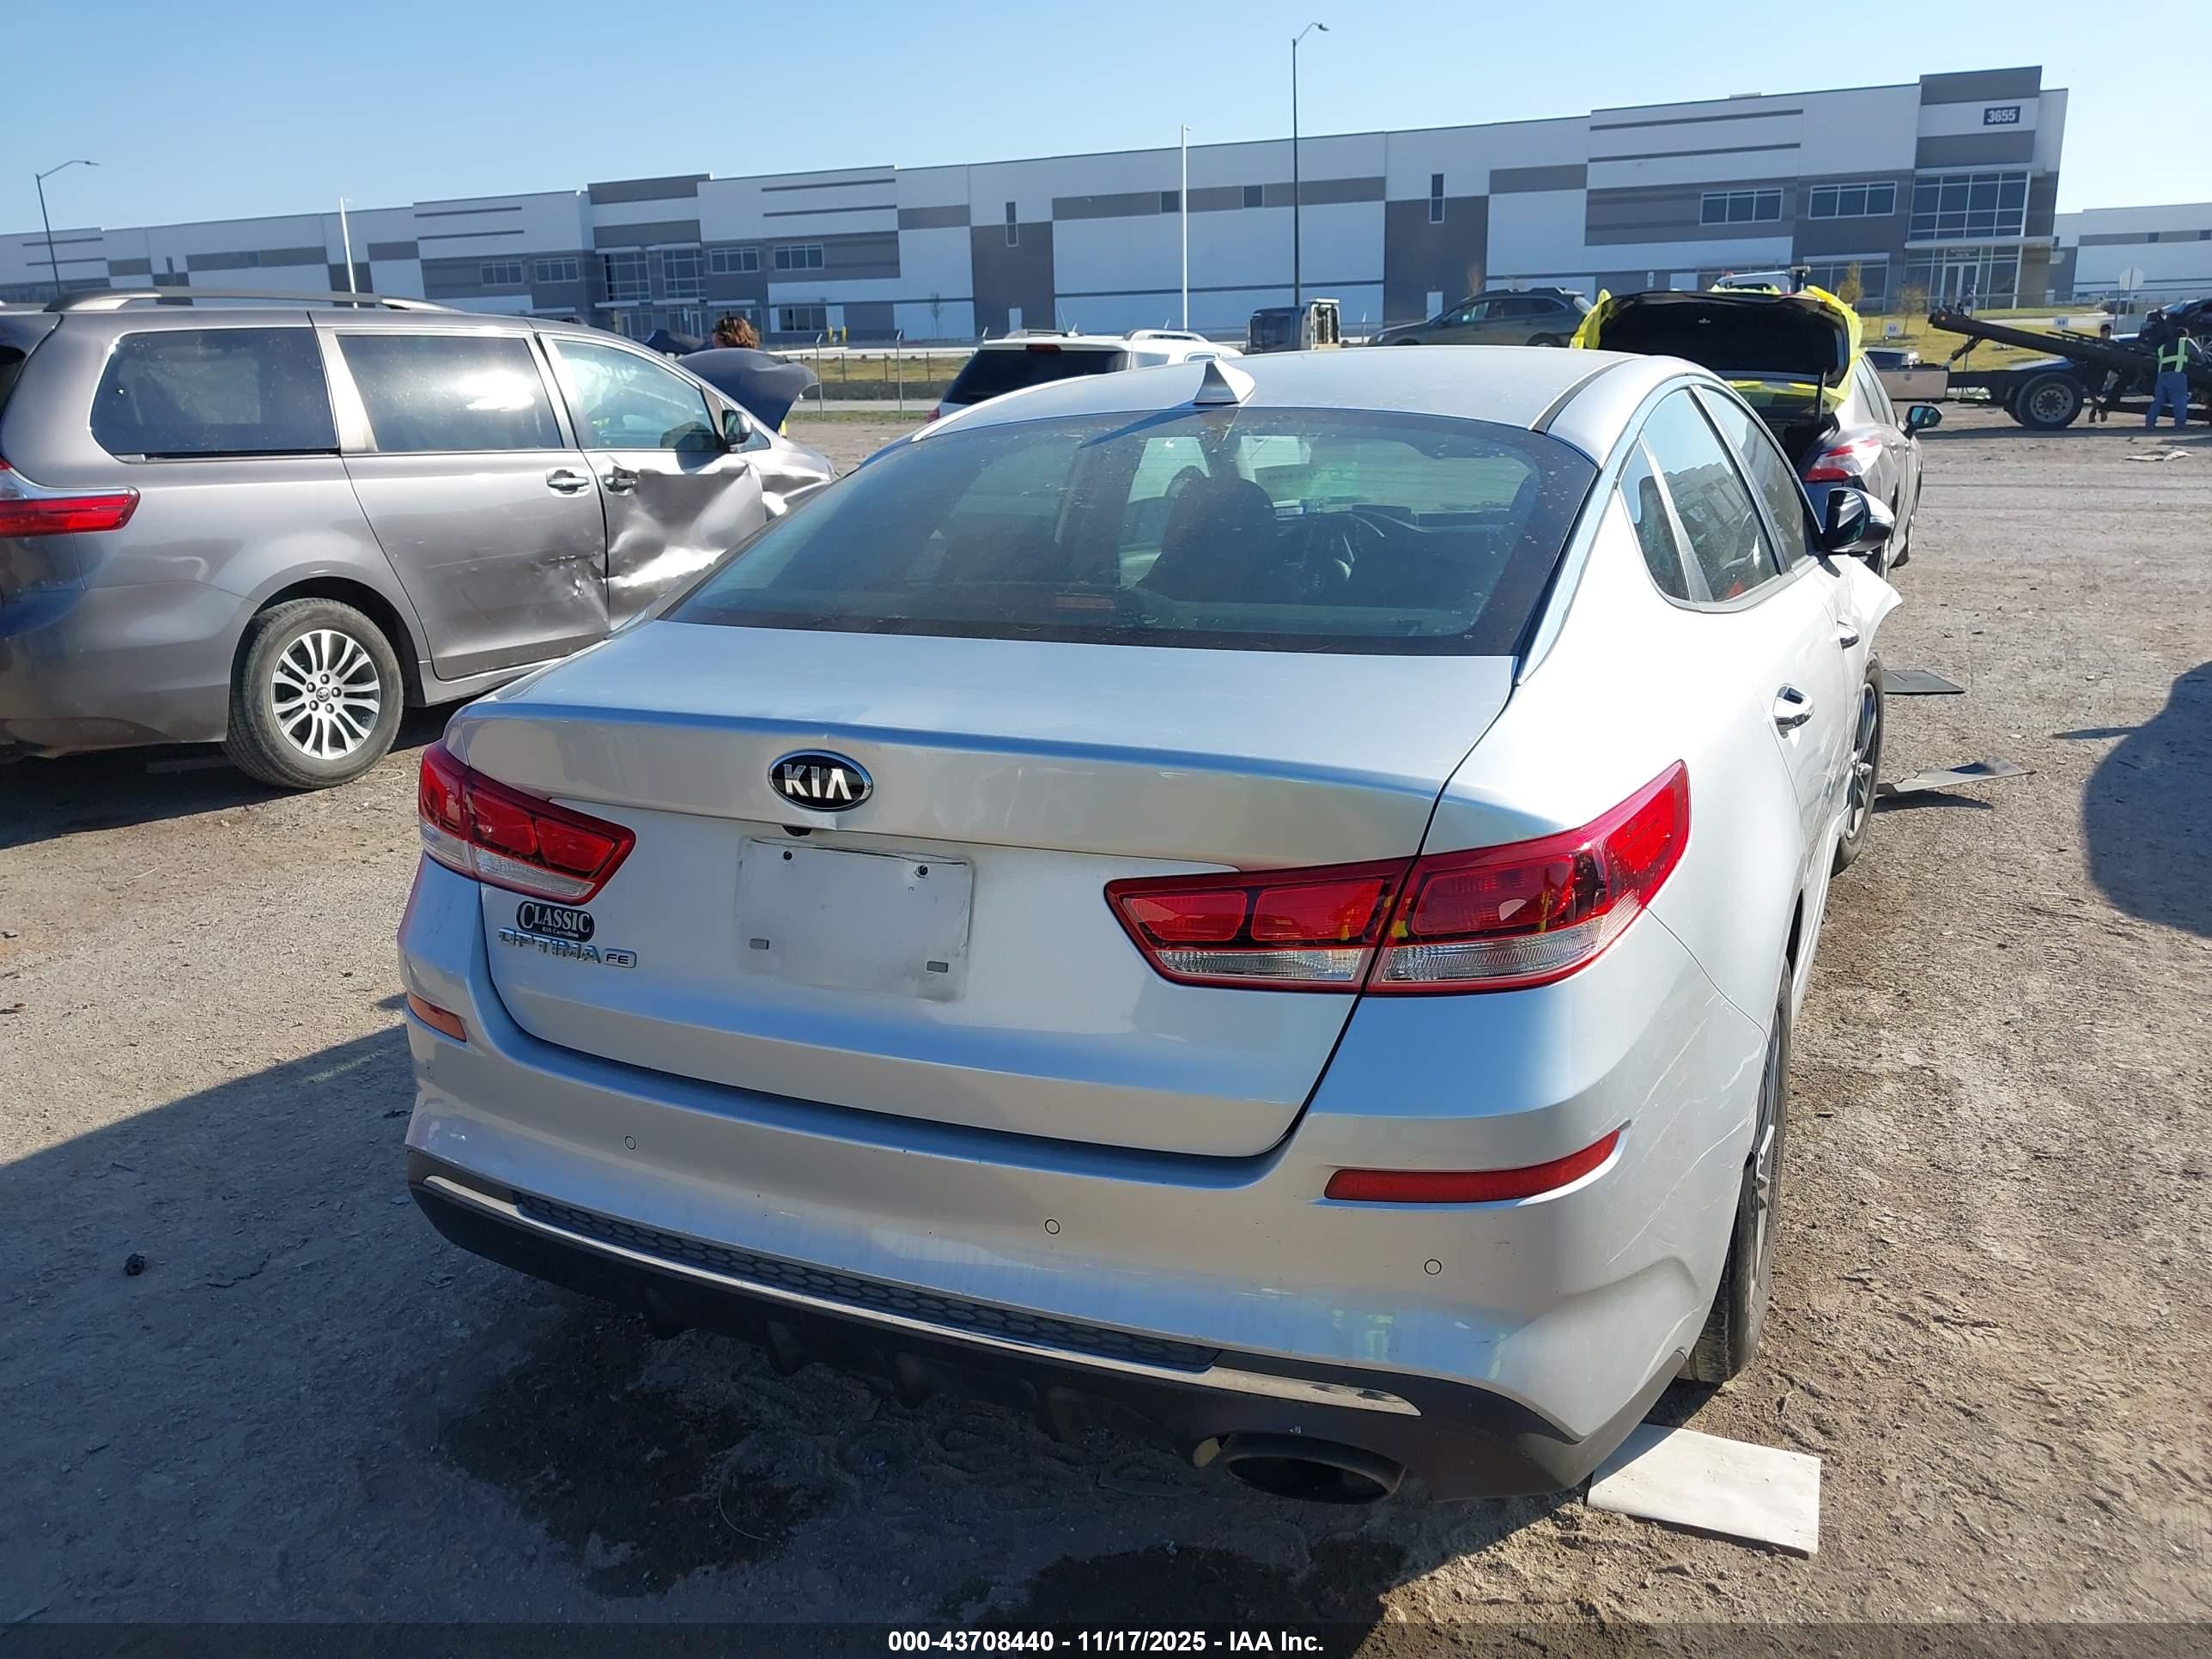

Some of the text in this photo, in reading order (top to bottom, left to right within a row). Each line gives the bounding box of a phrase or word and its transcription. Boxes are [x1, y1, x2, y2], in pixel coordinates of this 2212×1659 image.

[1987, 109, 2016, 123] 3655
[782, 763, 853, 800] KIA
[520, 902, 591, 933] CLASSIC
[498, 927, 629, 964] OPTIMA FE
